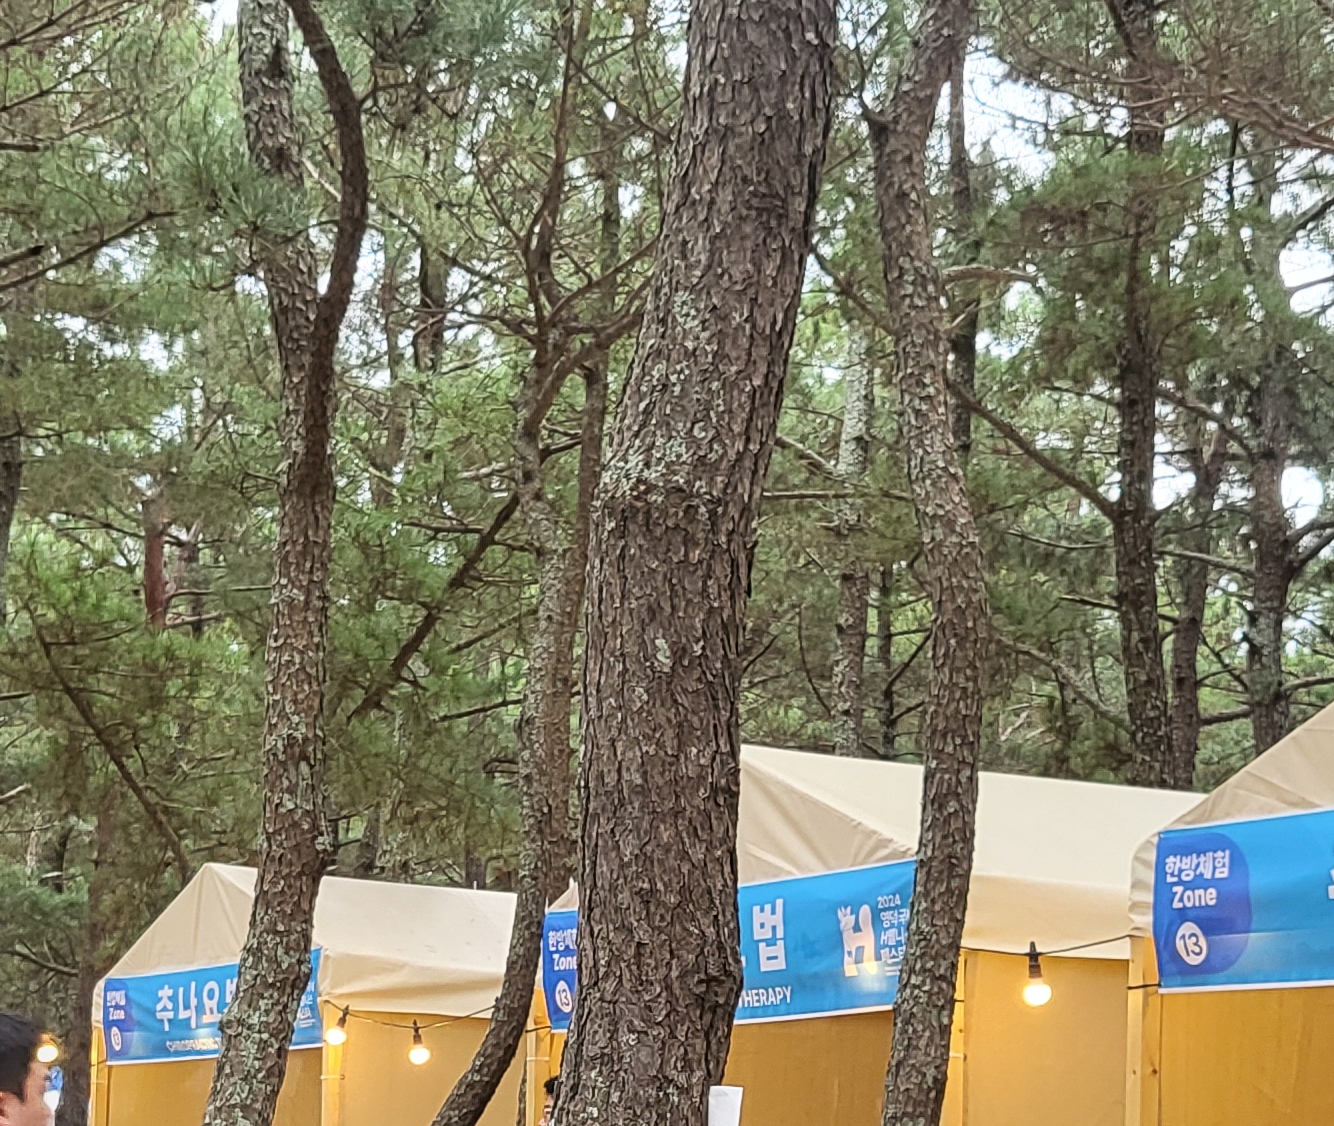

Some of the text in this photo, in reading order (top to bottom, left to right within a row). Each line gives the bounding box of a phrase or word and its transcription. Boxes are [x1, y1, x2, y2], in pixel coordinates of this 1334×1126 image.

[1165, 849, 1229, 883] 한방체험
[877, 893, 901, 909] 2024
[1172, 886, 1217, 909] Zone
[1179, 932, 1203, 957] 13
[558, 988, 570, 1007] 13
